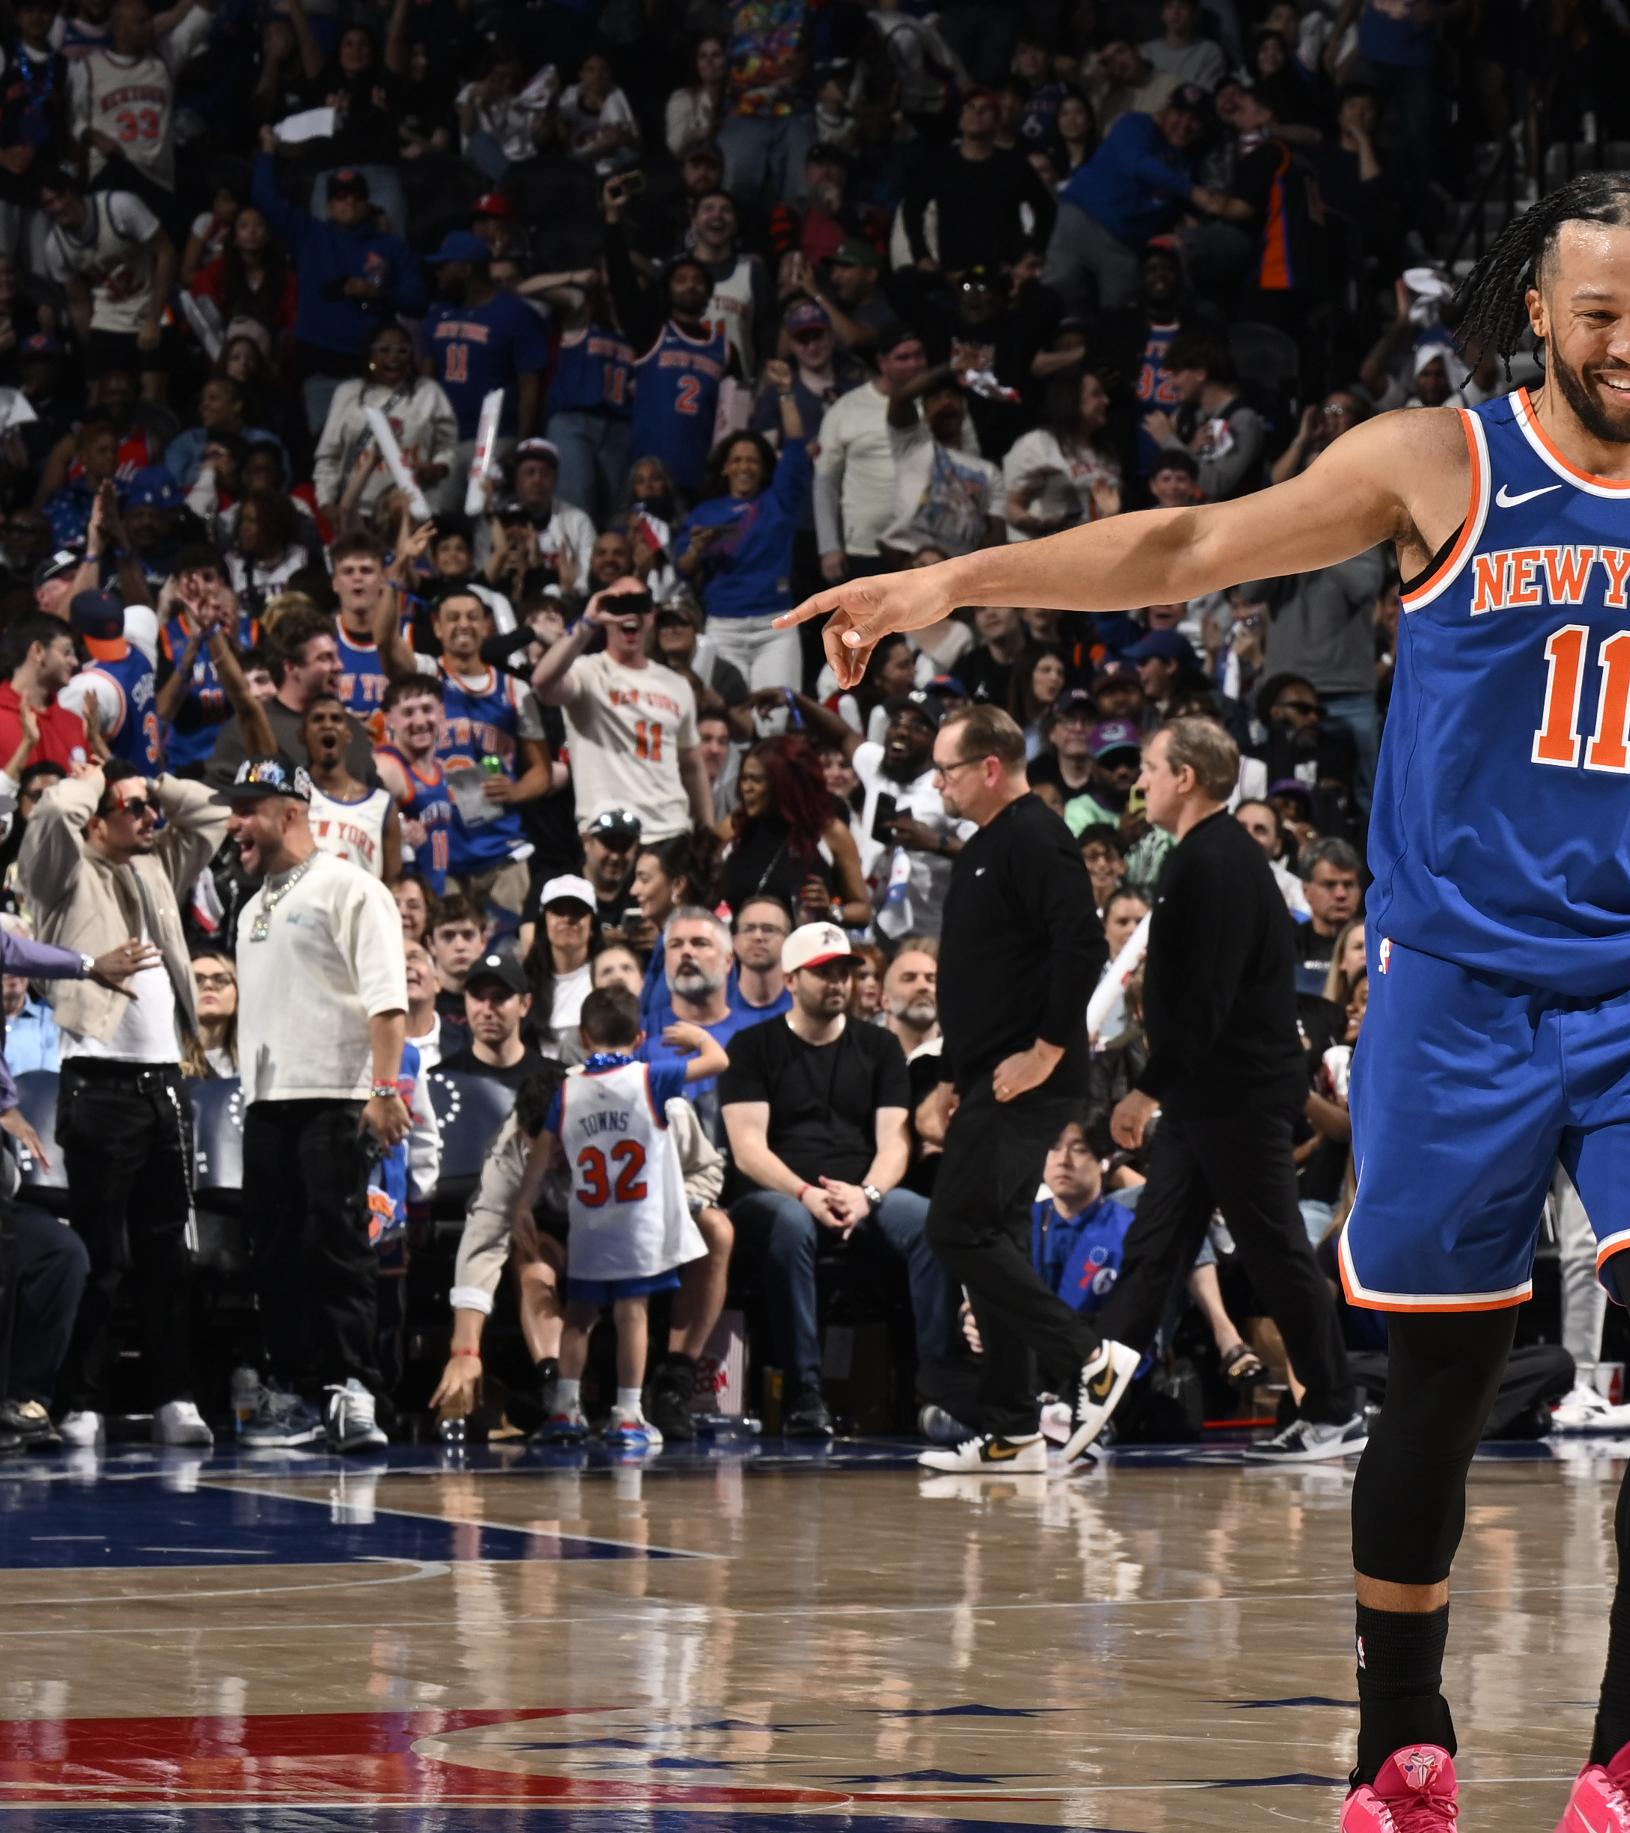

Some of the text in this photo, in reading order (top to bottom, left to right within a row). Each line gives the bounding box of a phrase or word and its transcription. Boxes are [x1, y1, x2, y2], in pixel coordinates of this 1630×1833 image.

[115, 109, 160, 144] 33
[445, 341, 470, 384] 11
[674, 374, 702, 416] 2
[1470, 545, 1598, 617] NEW
[634, 719, 662, 763] 11
[578, 1110, 630, 1138] TOWNS
[576, 1139, 648, 1209] 32
